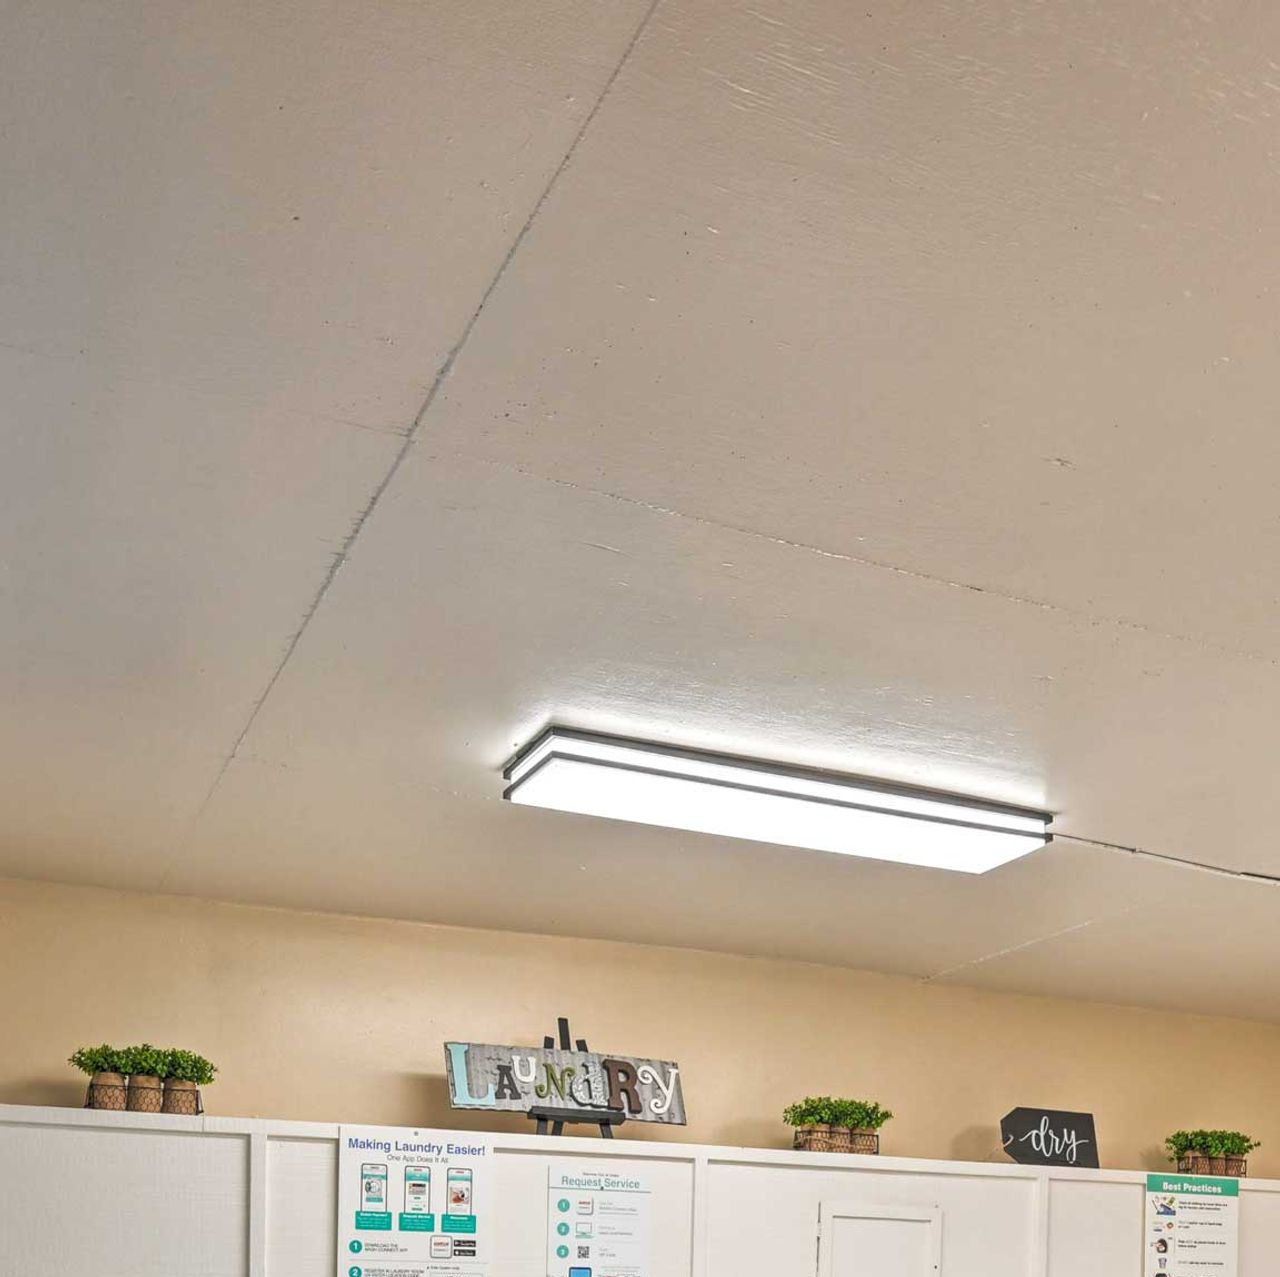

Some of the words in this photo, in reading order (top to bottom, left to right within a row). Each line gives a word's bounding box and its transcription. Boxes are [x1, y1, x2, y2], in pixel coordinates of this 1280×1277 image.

[348, 1138, 391, 1153] Making
[395, 1141, 443, 1155] Laundry
[447, 1143, 485, 1156] Easier!
[1019, 1115, 1089, 1164] dry
[561, 1176, 601, 1188] Request
[604, 1178, 640, 1189] Service
[1162, 1182, 1181, 1190] Best
[1183, 1183, 1222, 1193] Practices
